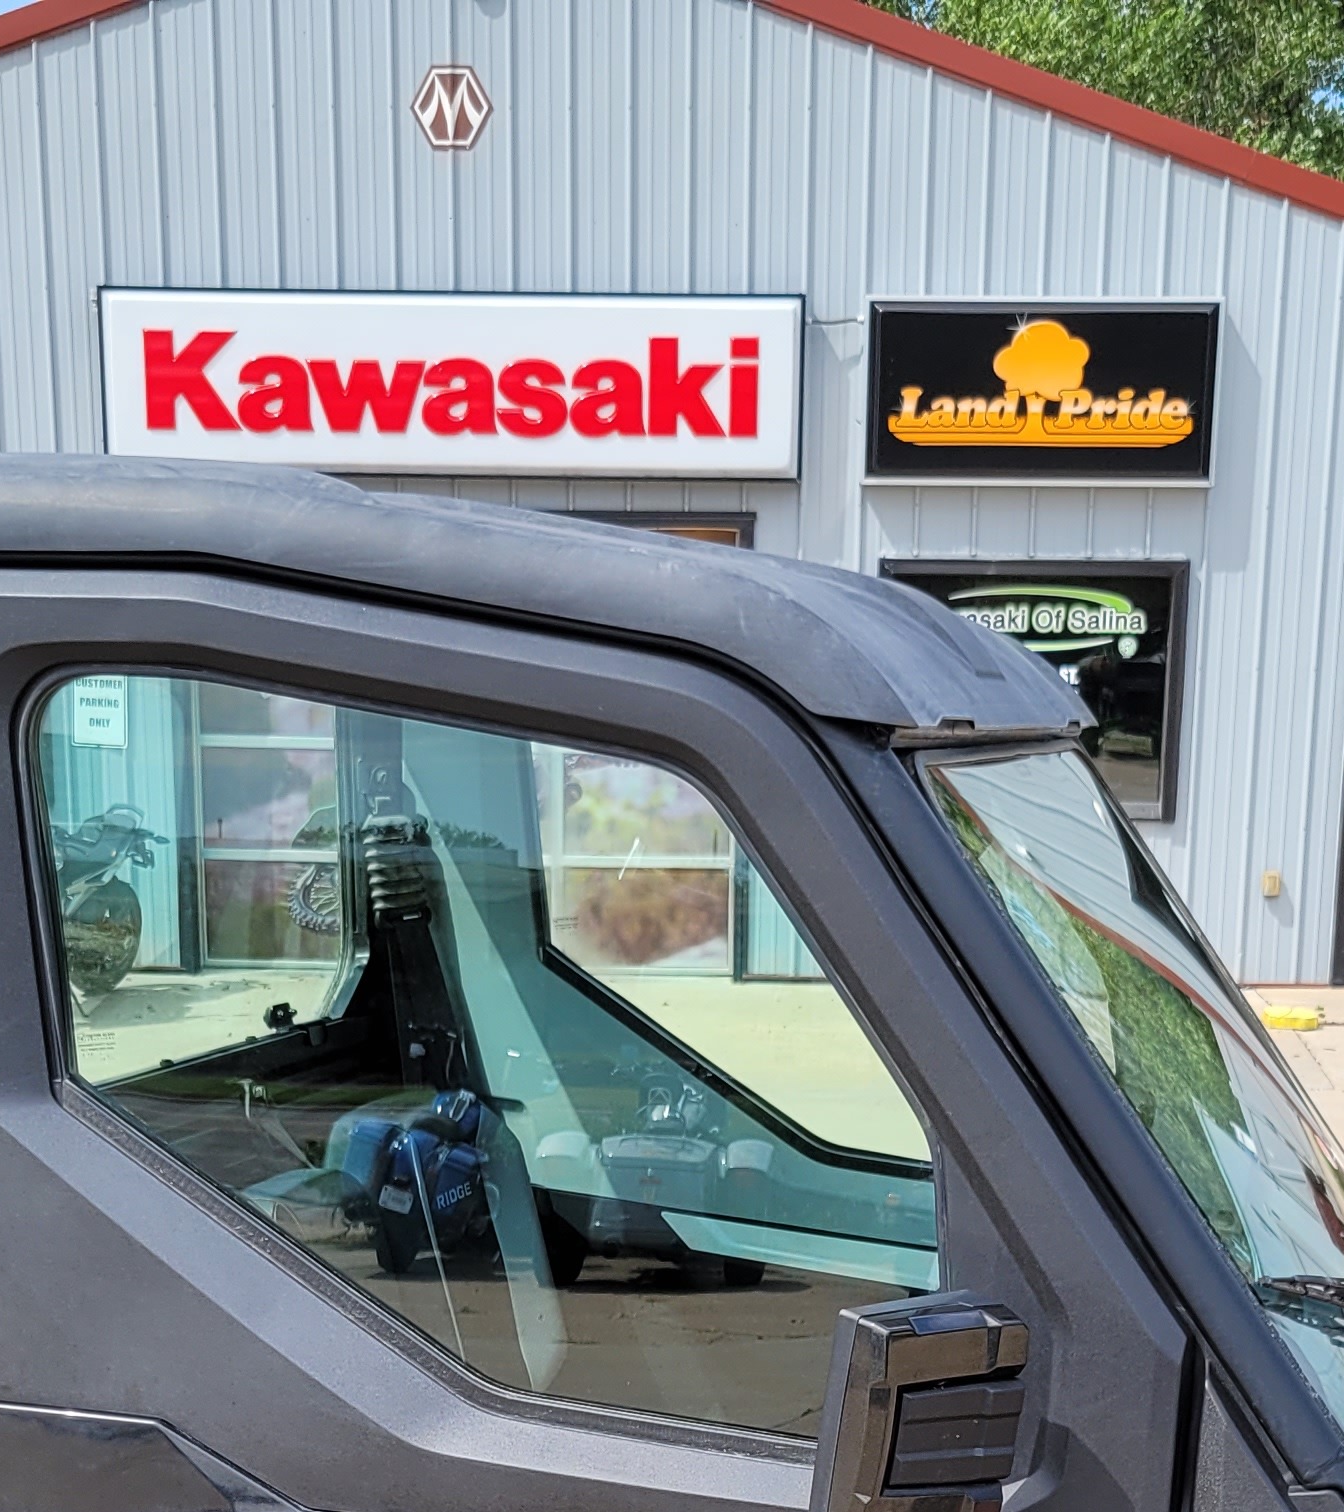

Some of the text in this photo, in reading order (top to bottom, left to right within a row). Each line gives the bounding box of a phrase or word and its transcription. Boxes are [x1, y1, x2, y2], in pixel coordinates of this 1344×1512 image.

[142, 328, 761, 439] Kawasaki
[895, 386, 1189, 430] Land Pride
[1034, 609, 1062, 630] Of
[1070, 609, 1144, 631] Salina
[75, 678, 123, 690] CUSTOMER
[79, 697, 120, 708] PARKING
[88, 717, 111, 728] ONLY
[436, 1181, 473, 1210] RIDGE
